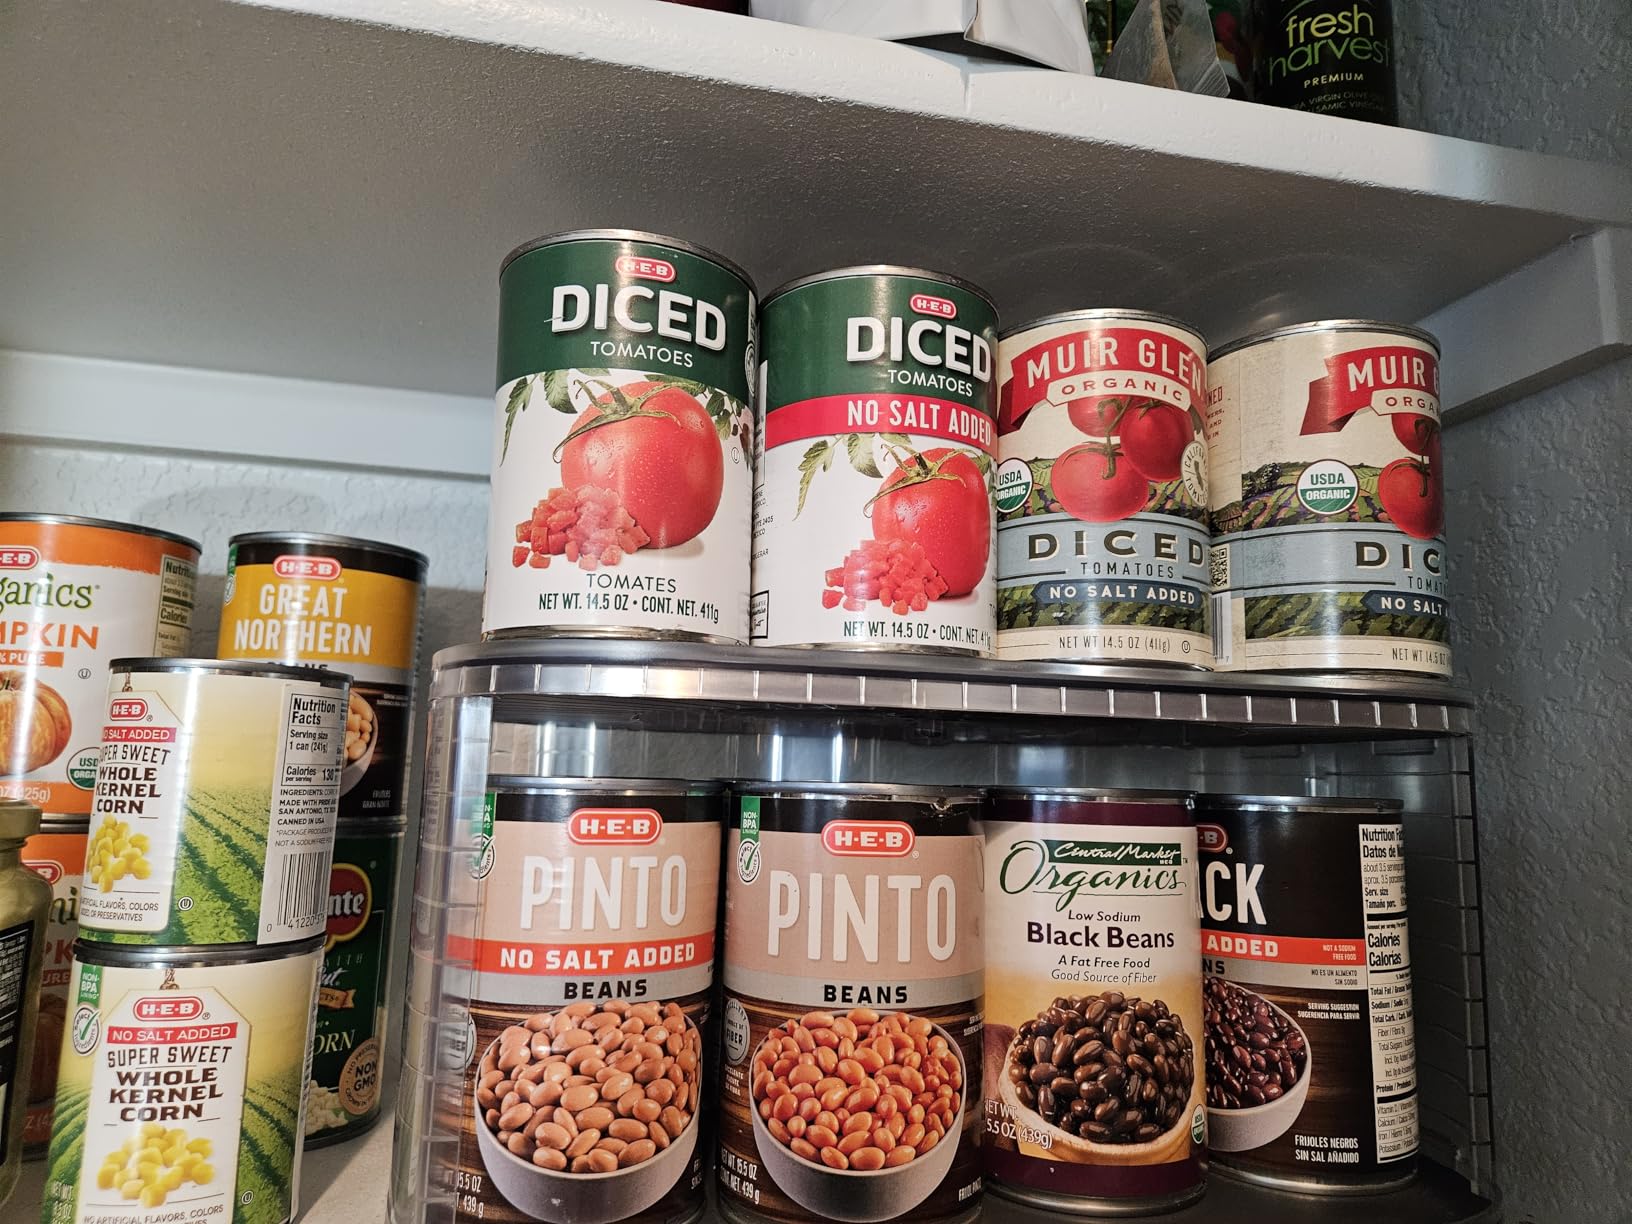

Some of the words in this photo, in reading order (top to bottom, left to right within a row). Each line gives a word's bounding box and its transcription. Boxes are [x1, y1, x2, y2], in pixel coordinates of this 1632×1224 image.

[1286, 4, 1374, 48] fresh
[1304, 73, 1364, 88] PREMIUM
[1308, 92, 1341, 105] VIRGIN
[551, 283, 727, 351] DICED
[590, 341, 694, 369] TOMATOES
[846, 316, 992, 383] DICED
[1027, 337, 1119, 388] MUIR
[1138, 338, 1201, 395] GLEN
[1347, 355, 1425, 392] MUIR
[888, 369, 973, 397] TOMATOES
[1062, 378, 1183, 400] ORGANIC
[848, 400, 879, 427] NO
[889, 400, 940, 430] SALT
[948, 408, 991, 447] ADDED
[999, 469, 1022, 486] USDA
[1310, 472, 1345, 485] USDA
[997, 485, 1026, 501] ORGANIC
[1306, 489, 1350, 500] ORGANIC
[1028, 530, 1204, 566] DICED
[1355, 541, 1440, 576] DIC
[1081, 562, 1174, 578] TOMATOES
[586, 573, 677, 593] TOMATES
[259, 584, 348, 618] GREAT
[1050, 585, 1077, 599] NO
[1088, 585, 1138, 599] SALT
[1147, 586, 1195, 605] ADDED
[539, 593, 559, 610] NET
[563, 593, 582, 610] WT.
[586, 593, 609, 610] 14.5
[614, 594, 629, 611] OZ
[641, 596, 674, 615] CONT.
[677, 599, 698, 618] NET.
[700, 602, 719, 624] 411g
[1381, 597, 1406, 609] NO
[1413, 600, 1442, 615] SALT
[234, 618, 373, 656] NORTHERN
[844, 621, 865, 637] NET
[868, 621, 888, 638] WT.
[892, 623, 913, 638] 14.5
[917, 624, 929, 639] OZ
[939, 624, 964, 641] CONT.
[966, 629, 980, 645] NET.
[1059, 636, 1078, 649] NET
[1083, 636, 1097, 649] WT
[1103, 636, 1123, 649] 14.5
[1128, 636, 1140, 649] OZ
[1145, 637, 1170, 653] (411g)
[1392, 648, 1408, 660] NET
[1412, 649, 1422, 661] WT
[293, 698, 336, 713] Nutrition
[291, 711, 322, 725] Facts
[109, 729, 127, 739] SALT
[128, 729, 170, 740] ADDED
[290, 729, 317, 740] Serving
[317, 731, 328, 740] size
[121, 744, 171, 765] SWEET
[99, 766, 158, 781] WHOLE
[286, 765, 317, 776] Calories
[322, 768, 334, 781] 130
[96, 783, 162, 798] KERNEL
[96, 799, 144, 814] CORN
[295, 807, 323, 815] ANTONIO,
[743, 811, 758, 819] NON-
[277, 818, 307, 826] CANNED
[742, 819, 757, 829] BPA
[274, 839, 289, 847] NOT
[1362, 827, 1396, 842] Nutrition
[1055, 842, 1120, 858] Central
[1117, 843, 1180, 860] Market
[1363, 845, 1387, 858] Datos
[1388, 845, 1396, 858] de
[1000, 840, 1186, 912] Organics
[1363, 863, 1378, 872] about
[1379, 863, 1387, 872] 3.5
[1363, 875, 1380, 886] aprox.
[520, 855, 687, 930] PINTO
[1364, 887, 1379, 897] Serv.
[1379, 887, 1389, 896] size
[128, 902, 159, 911] COLORS
[97, 910, 143, 922] PRESERVATIVES
[767, 870, 956, 962] PINTO
[1068, 910, 1094, 921] Low
[1097, 910, 1141, 923] Sodium
[266, 923, 273, 932] 0
[1027, 921, 1100, 948] Black
[1107, 926, 1175, 949] Beans
[1207, 935, 1279, 957] ADDED
[1322, 944, 1333, 952] NOT
[1367, 931, 1401, 948] Calories
[500, 947, 534, 969] NO
[546, 949, 614, 970] SALT
[624, 942, 695, 969] ADDED
[1058, 954, 1067, 966] A
[1071, 956, 1090, 967] Fat
[1094, 956, 1120, 968] Free
[1123, 957, 1150, 968] Food
[1332, 953, 1344, 961] FREE
[1344, 953, 1357, 961] FOOD
[82, 972, 99, 981] NON-
[1051, 968, 1080, 982] Good
[1083, 971, 1119, 983] Source
[1121, 971, 1134, 985] of
[1134, 972, 1158, 983] Fiber
[1335, 969, 1358, 977] ALIMENTO
[81, 980, 98, 993] BPA
[564, 979, 648, 1000] BEANS
[823, 984, 908, 1004] BEANS
[1370, 986, 1383, 996] Total
[1308, 1003, 1330, 1011] SERVING
[1330, 1003, 1360, 1012] SUGGESTION
[1371, 1000, 1390, 1010] Sodium
[1297, 1010, 1329, 1020] SUGERENCIA
[1330, 1012, 1343, 1020] PARA
[1343, 1012, 1360, 1020] SERVIR
[1371, 1014, 1384, 1024] Total
[112, 1031, 133, 1042] NO
[137, 1029, 172, 1041] SALT
[177, 1026, 231, 1040] ADDED
[726, 1029, 743, 1046] FIBER
[107, 1048, 159, 1068] SUPER
[168, 1045, 233, 1064] SWEET
[116, 1067, 219, 1086] WHOLE
[356, 1060, 377, 1077] NON
[354, 1074, 376, 1091] GMO
[109, 1084, 223, 1104] KERNEL
[119, 1103, 204, 1122] CORN
[1000, 1103, 1019, 1121] WT.
[1001, 1121, 1017, 1139] OZ
[1018, 1126, 1052, 1150] (439g)
[1295, 1135, 1329, 1149] FRIJOLES
[1330, 1136, 1359, 1149] NEGROS
[1295, 1150, 1309, 1162] SIN
[1311, 1151, 1326, 1163] SAL
[1327, 1150, 1360, 1164] AÑADIDO
[737, 1158, 748, 1177] 15.5
[749, 1163, 757, 1180] OZ
[472, 1175, 482, 1193] OZ
[742, 1181, 754, 1199] 439
[463, 1194, 477, 1212] 439
[144, 1211, 187, 1223] FLAVORS,
[190, 1204, 224, 1218] COLORS
